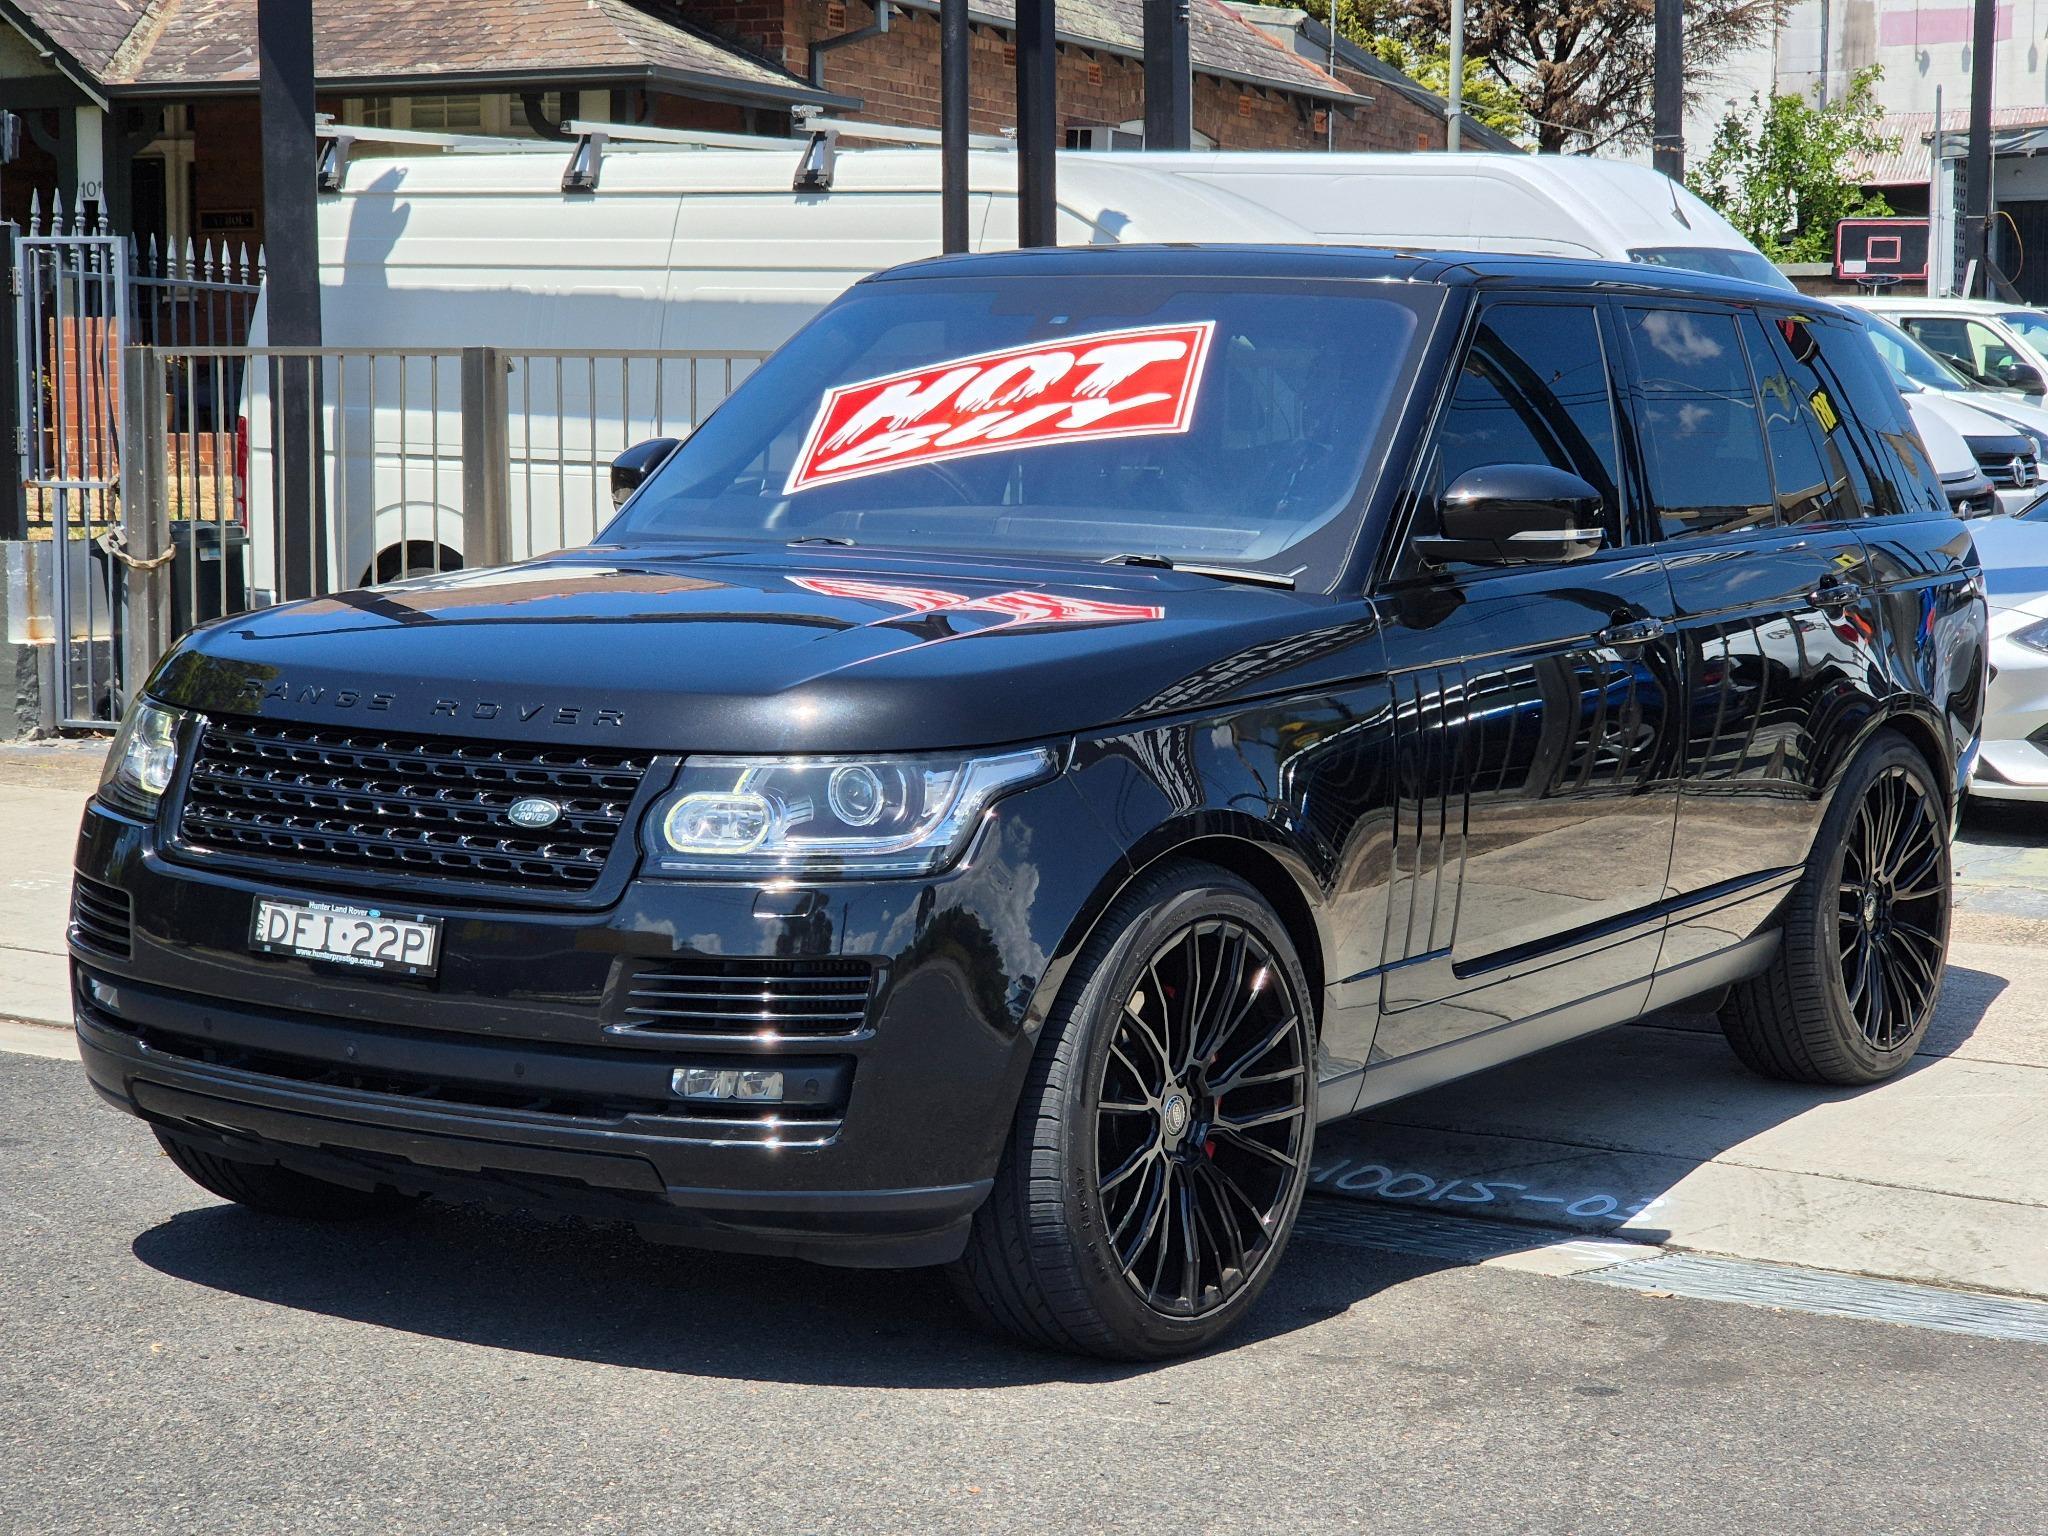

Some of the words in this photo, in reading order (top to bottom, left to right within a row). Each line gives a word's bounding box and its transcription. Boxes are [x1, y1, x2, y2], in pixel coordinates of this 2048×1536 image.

[818, 341, 1187, 456] HOT
[815, 392, 1172, 472] BUY
[236, 678, 397, 711] RANGE
[430, 699, 625, 727] ROVER
[518, 803, 545, 812] LAND
[518, 811, 550, 822] ROVER
[308, 901, 331, 912] Hunter
[332, 904, 348, 914] Land
[348, 907, 369, 917] Rover
[295, 948, 385, 969] www.hunterprestige.com.au
